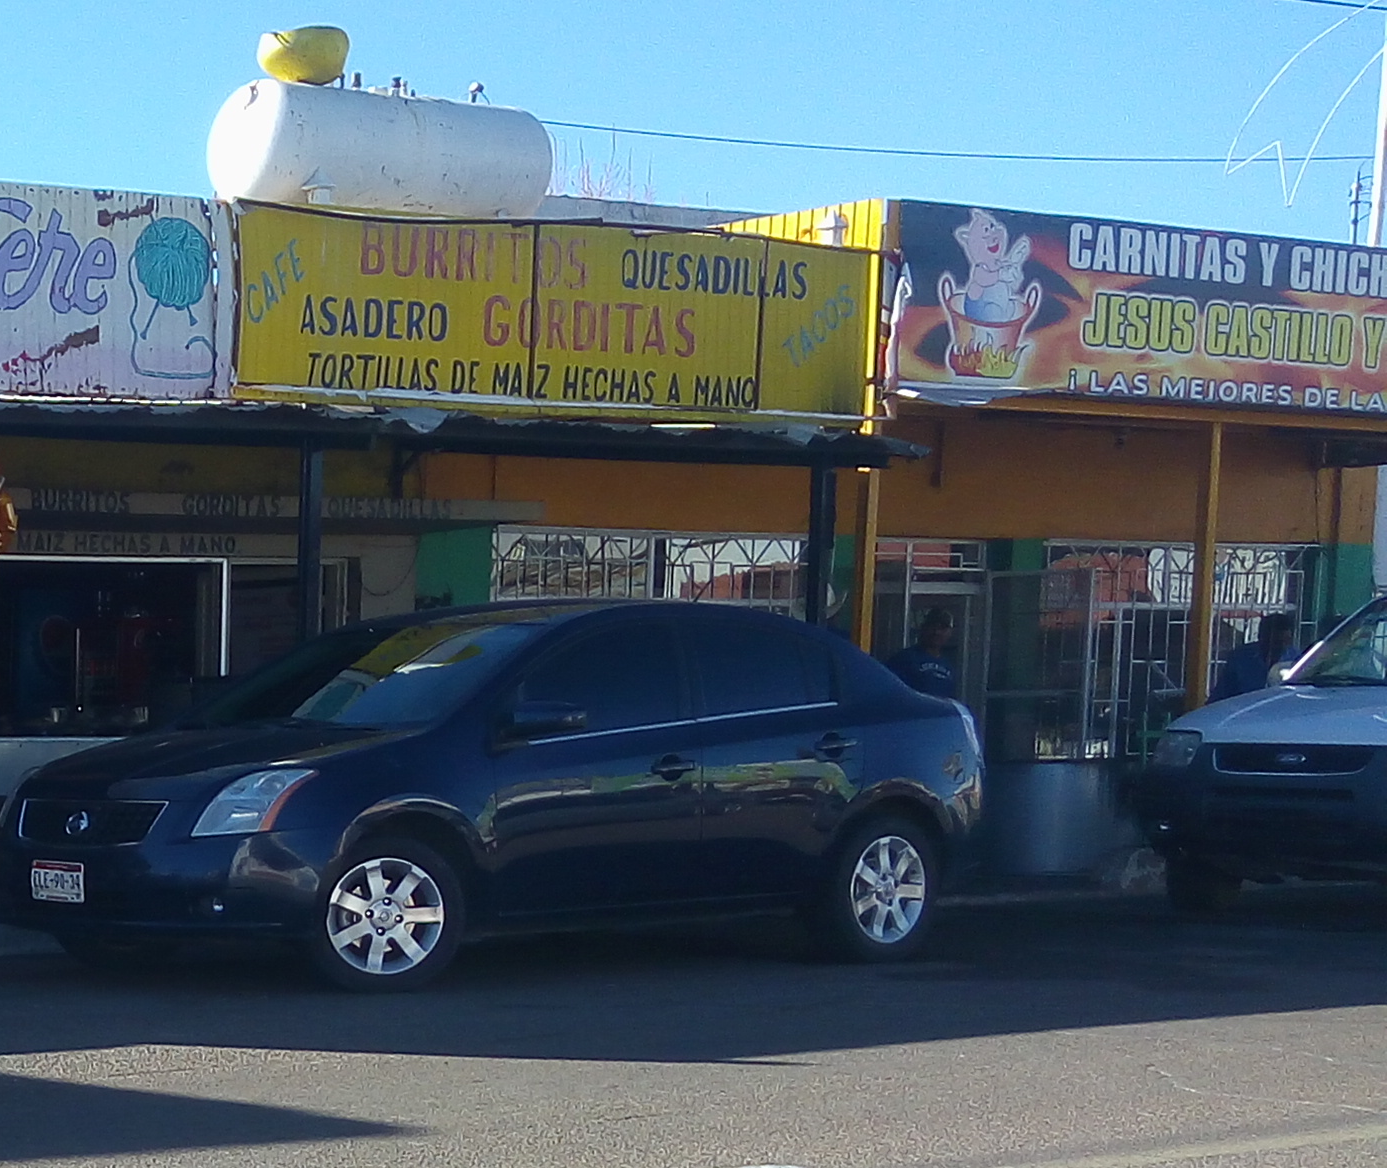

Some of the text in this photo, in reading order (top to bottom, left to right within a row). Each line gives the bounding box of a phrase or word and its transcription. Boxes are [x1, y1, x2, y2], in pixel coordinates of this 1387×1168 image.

[245, 238, 305, 324] CAFE
[360, 222, 809, 300] BURRITOS QUESADILLAS
[1068, 222, 1387, 298] CARNITAS Y CHICH
[300, 294, 696, 358] ASADERO GORDITAS
[782, 284, 858, 368] TACOS
[1083, 293, 1385, 369] JESUS CASTILLO Y
[308, 352, 756, 408] TORTILLAS DE MAZ HECHAS A MANO
[1160, 376, 1293, 406] MEJORES
[1304, 387, 1339, 407] DE
[31, 488, 451, 521] BURRITOS GORDITAS QUESADILLAS
[17, 531, 64, 553] MAIZ
[75, 531, 151, 554] HECHAS
[159, 534, 171, 553] A
